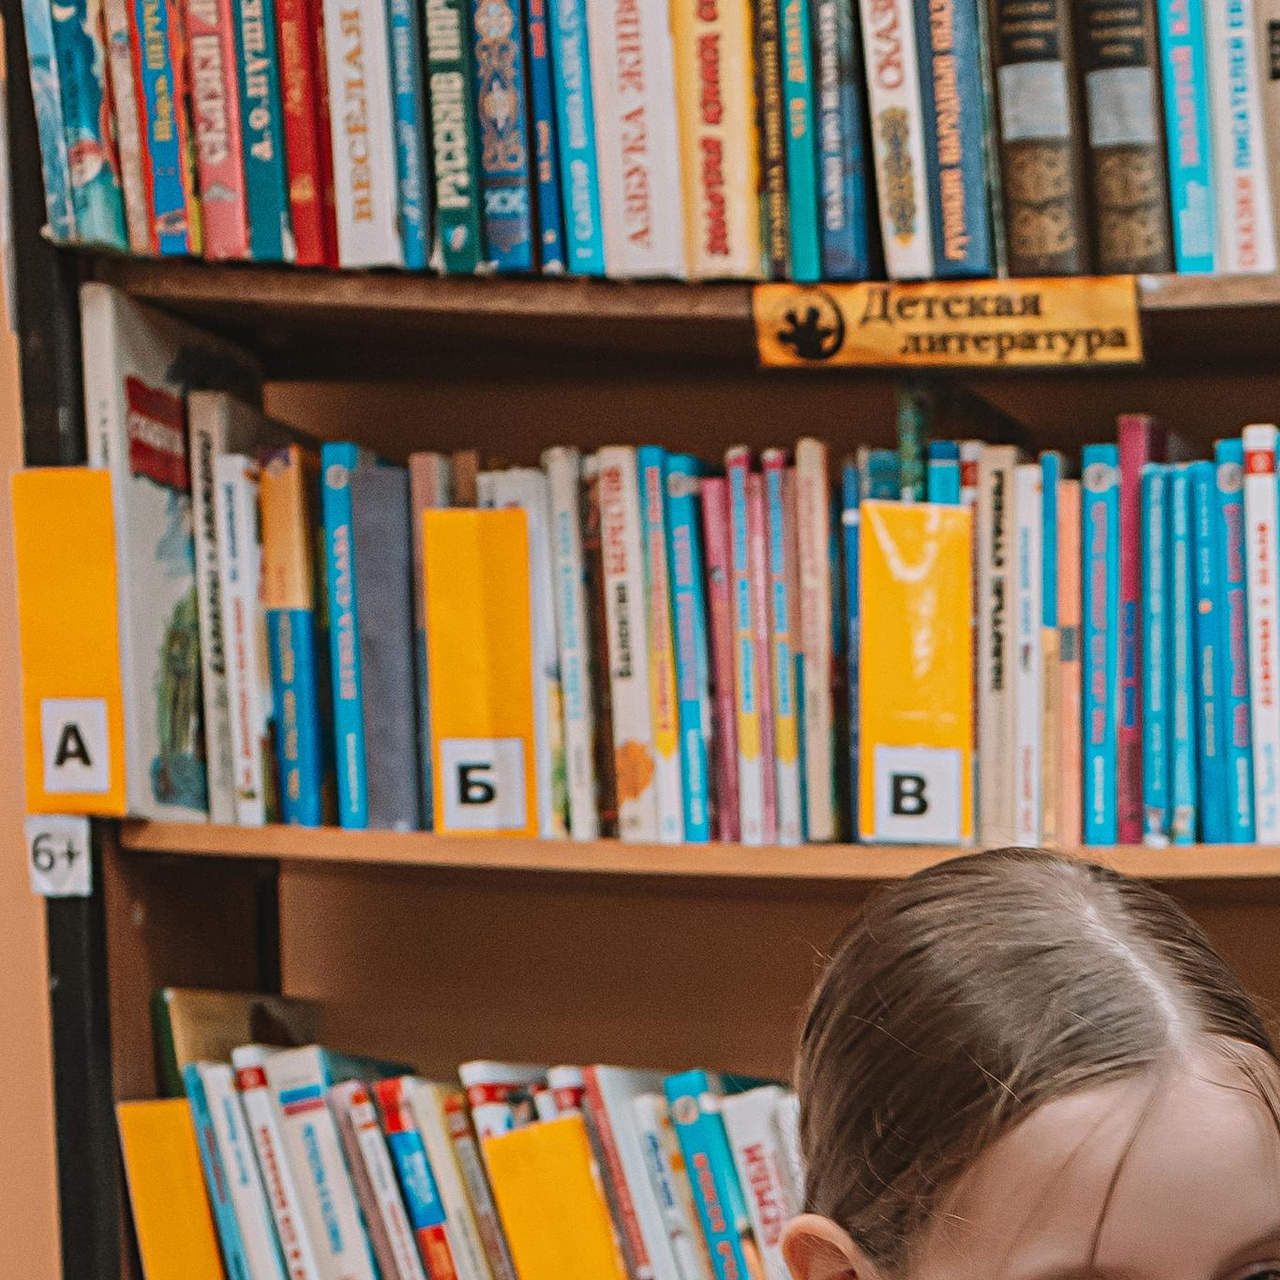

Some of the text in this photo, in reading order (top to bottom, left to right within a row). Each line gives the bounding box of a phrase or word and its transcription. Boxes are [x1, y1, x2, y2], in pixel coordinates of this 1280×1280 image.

[190, 35, 228, 166] СКАЗКИ
[339, 6, 374, 223] ВЕСЕЛАЯ
[1226, 37, 1252, 169] ПИСАТЕЛЕЙ
[620, 106, 652, 248] АЗБУКА
[1233, 176, 1259, 269] СКАЗКИ
[861, 288, 1041, 325] Детская
[899, 326, 1128, 358] литература
[54, 724, 92, 768] А
[457, 762, 496, 806] Б
[889, 773, 929, 817] В
[32, 831, 81, 874] 6+
